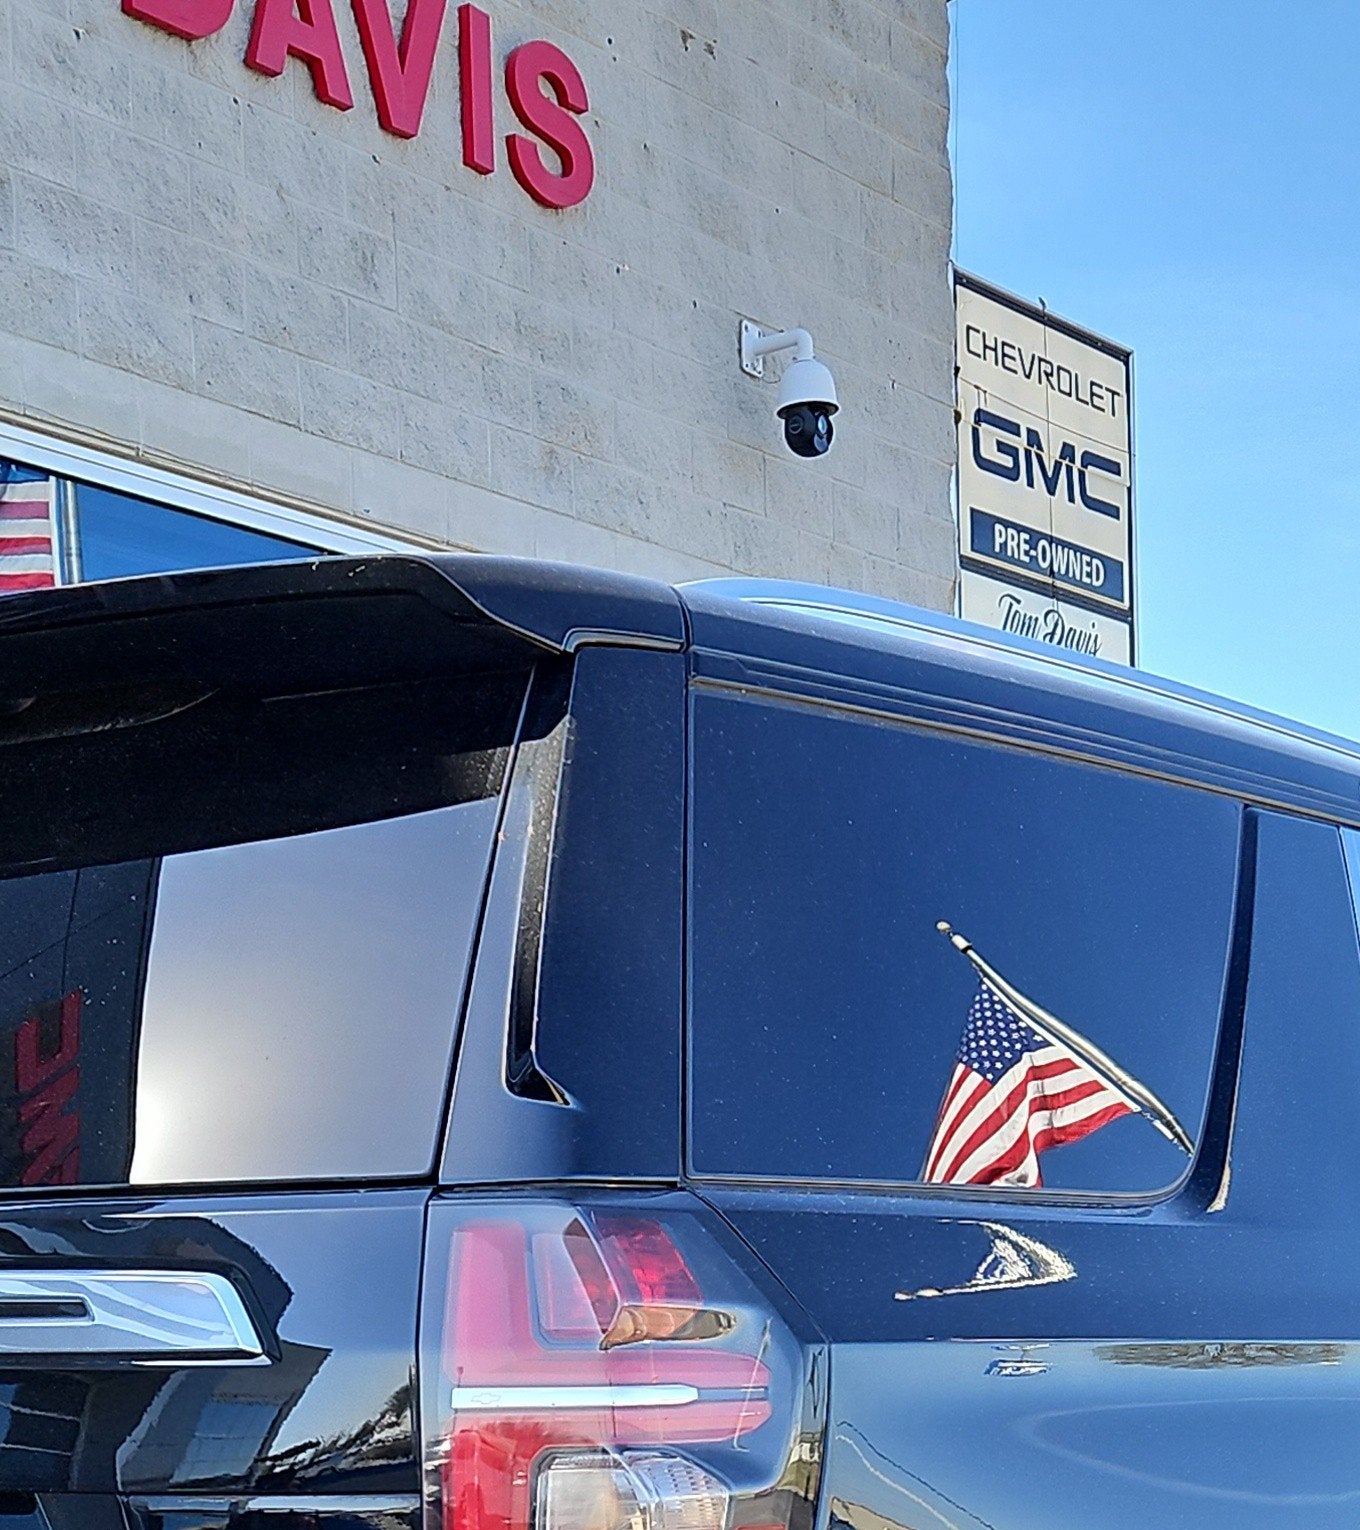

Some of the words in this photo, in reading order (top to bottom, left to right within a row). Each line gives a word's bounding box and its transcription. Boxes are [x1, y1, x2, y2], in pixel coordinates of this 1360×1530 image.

[122, 0, 594, 209] AVIS
[965, 324, 1122, 418] CHEVROLET
[971, 408, 1122, 521] GMC
[993, 521, 1105, 588] PRE-OWNED
[998, 593, 1040, 640] Tom
[1043, 609, 1102, 657] Davis
